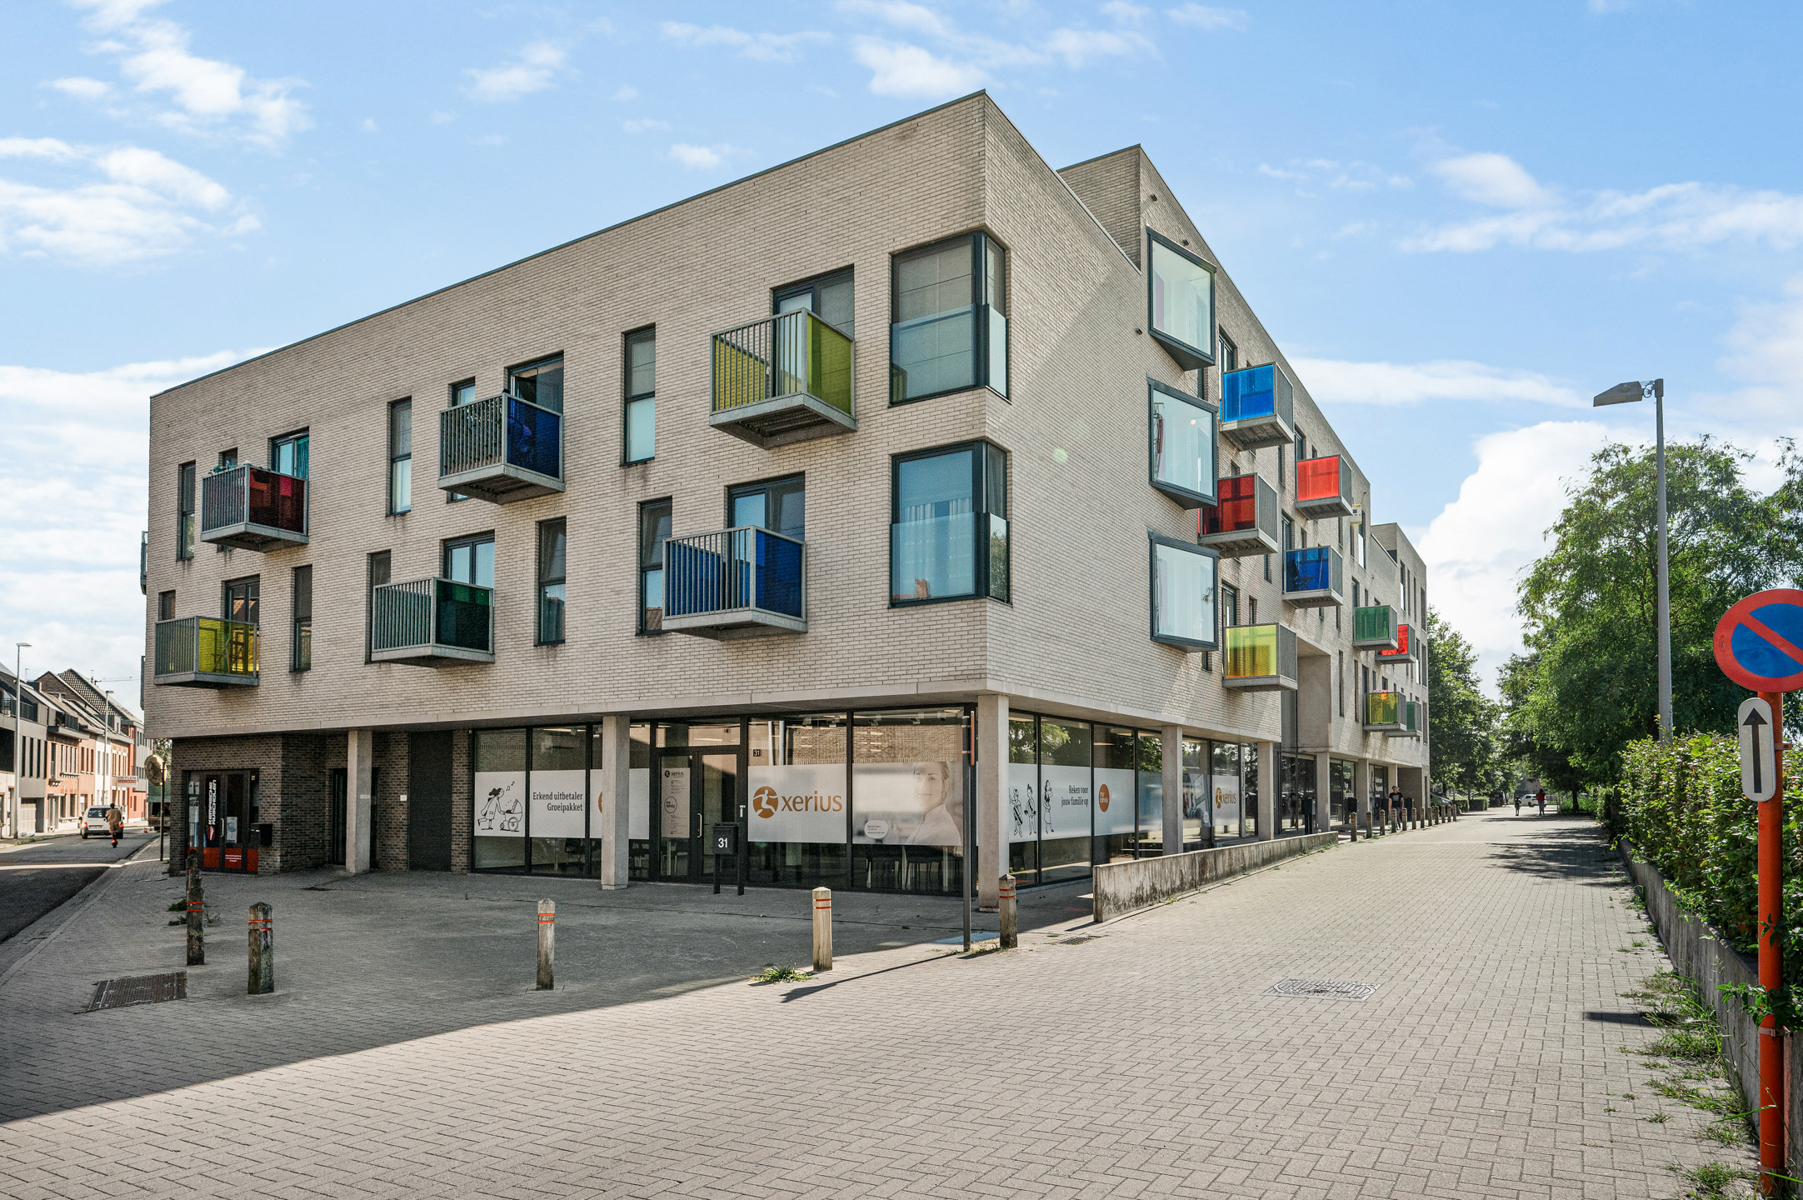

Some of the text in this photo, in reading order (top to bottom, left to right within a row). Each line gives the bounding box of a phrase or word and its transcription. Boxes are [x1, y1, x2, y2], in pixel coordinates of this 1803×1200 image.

[533, 791, 583, 800] Erkend uitbetaler
[781, 790, 843, 812] xerius
[1222, 790, 1237, 804] xerius
[547, 802, 583, 813] Groeipakket
[718, 837, 728, 848] 31
